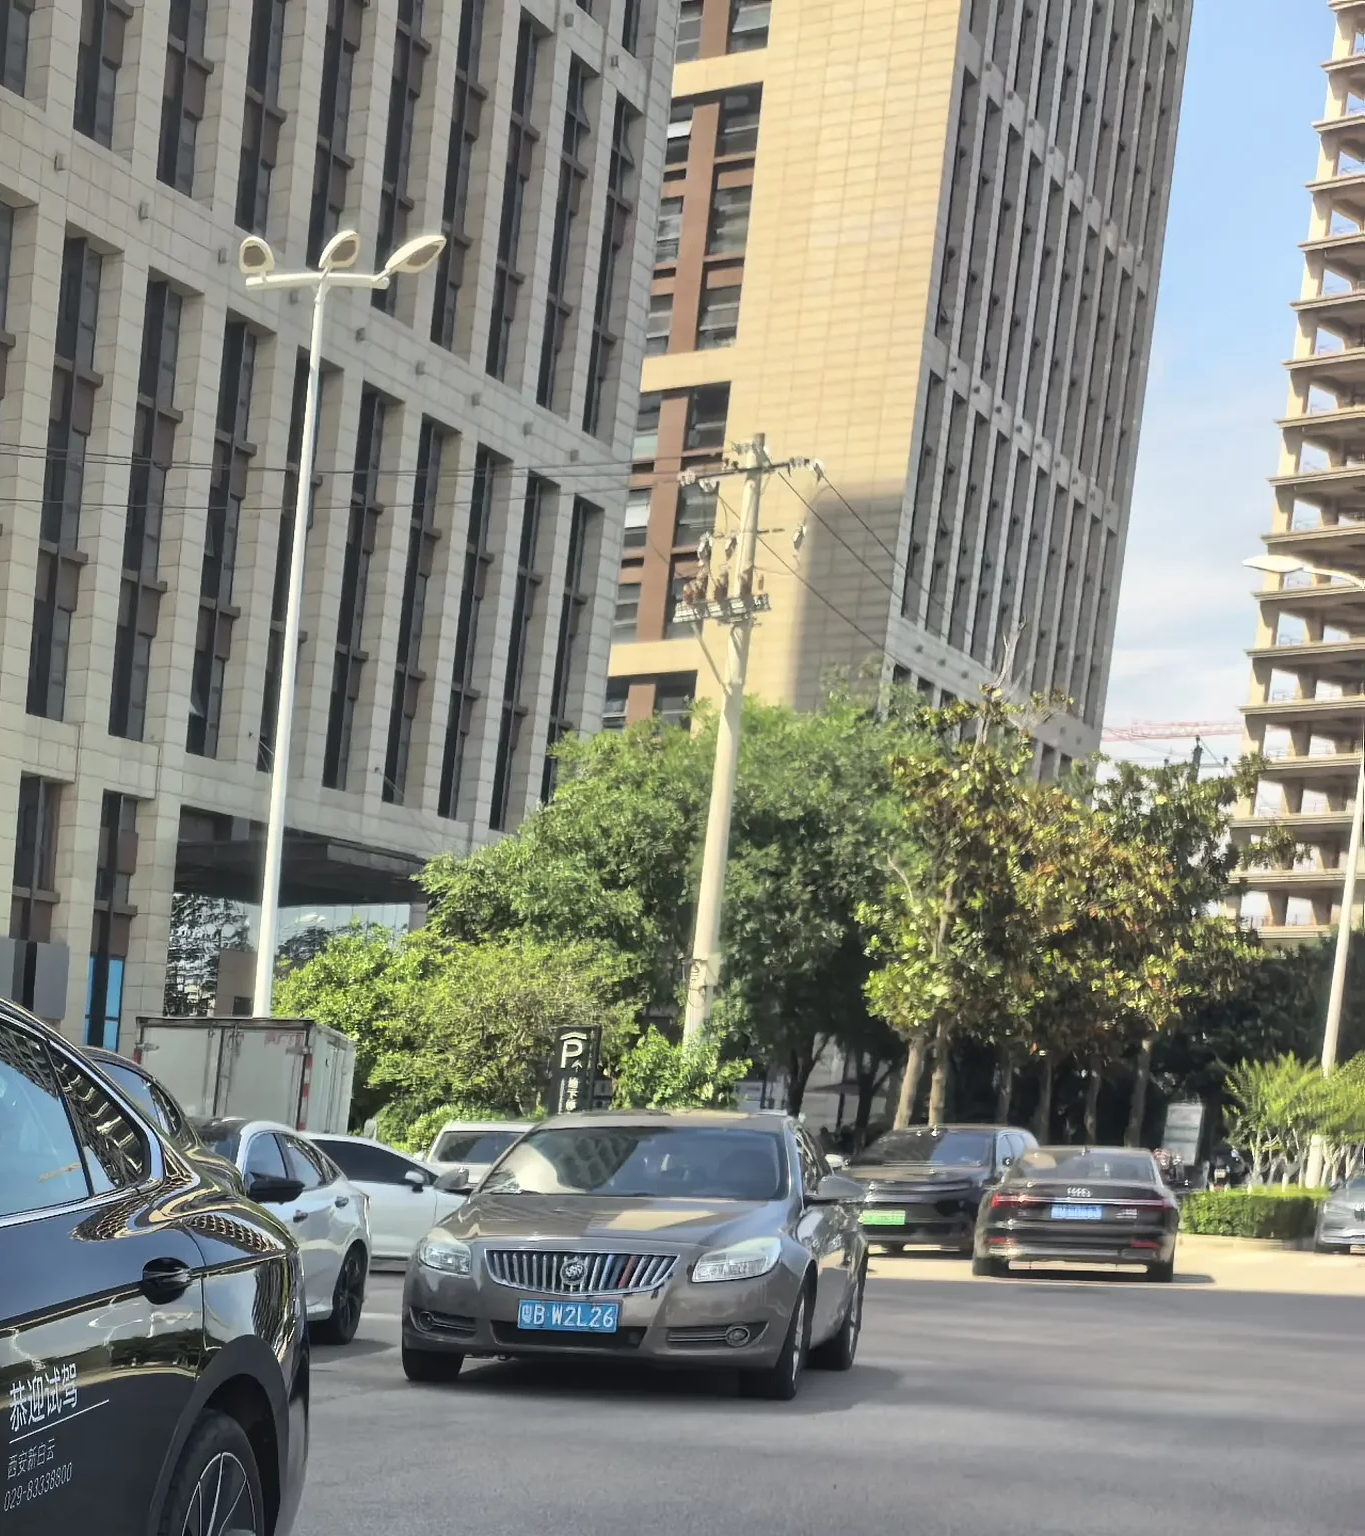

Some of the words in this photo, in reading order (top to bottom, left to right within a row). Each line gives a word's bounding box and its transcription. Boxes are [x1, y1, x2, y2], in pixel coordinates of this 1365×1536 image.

[560, 1039, 583, 1069] P
[9, 1362, 78, 1432] 恭迎试驾
[7, 1438, 56, 1480] 西安新白云
